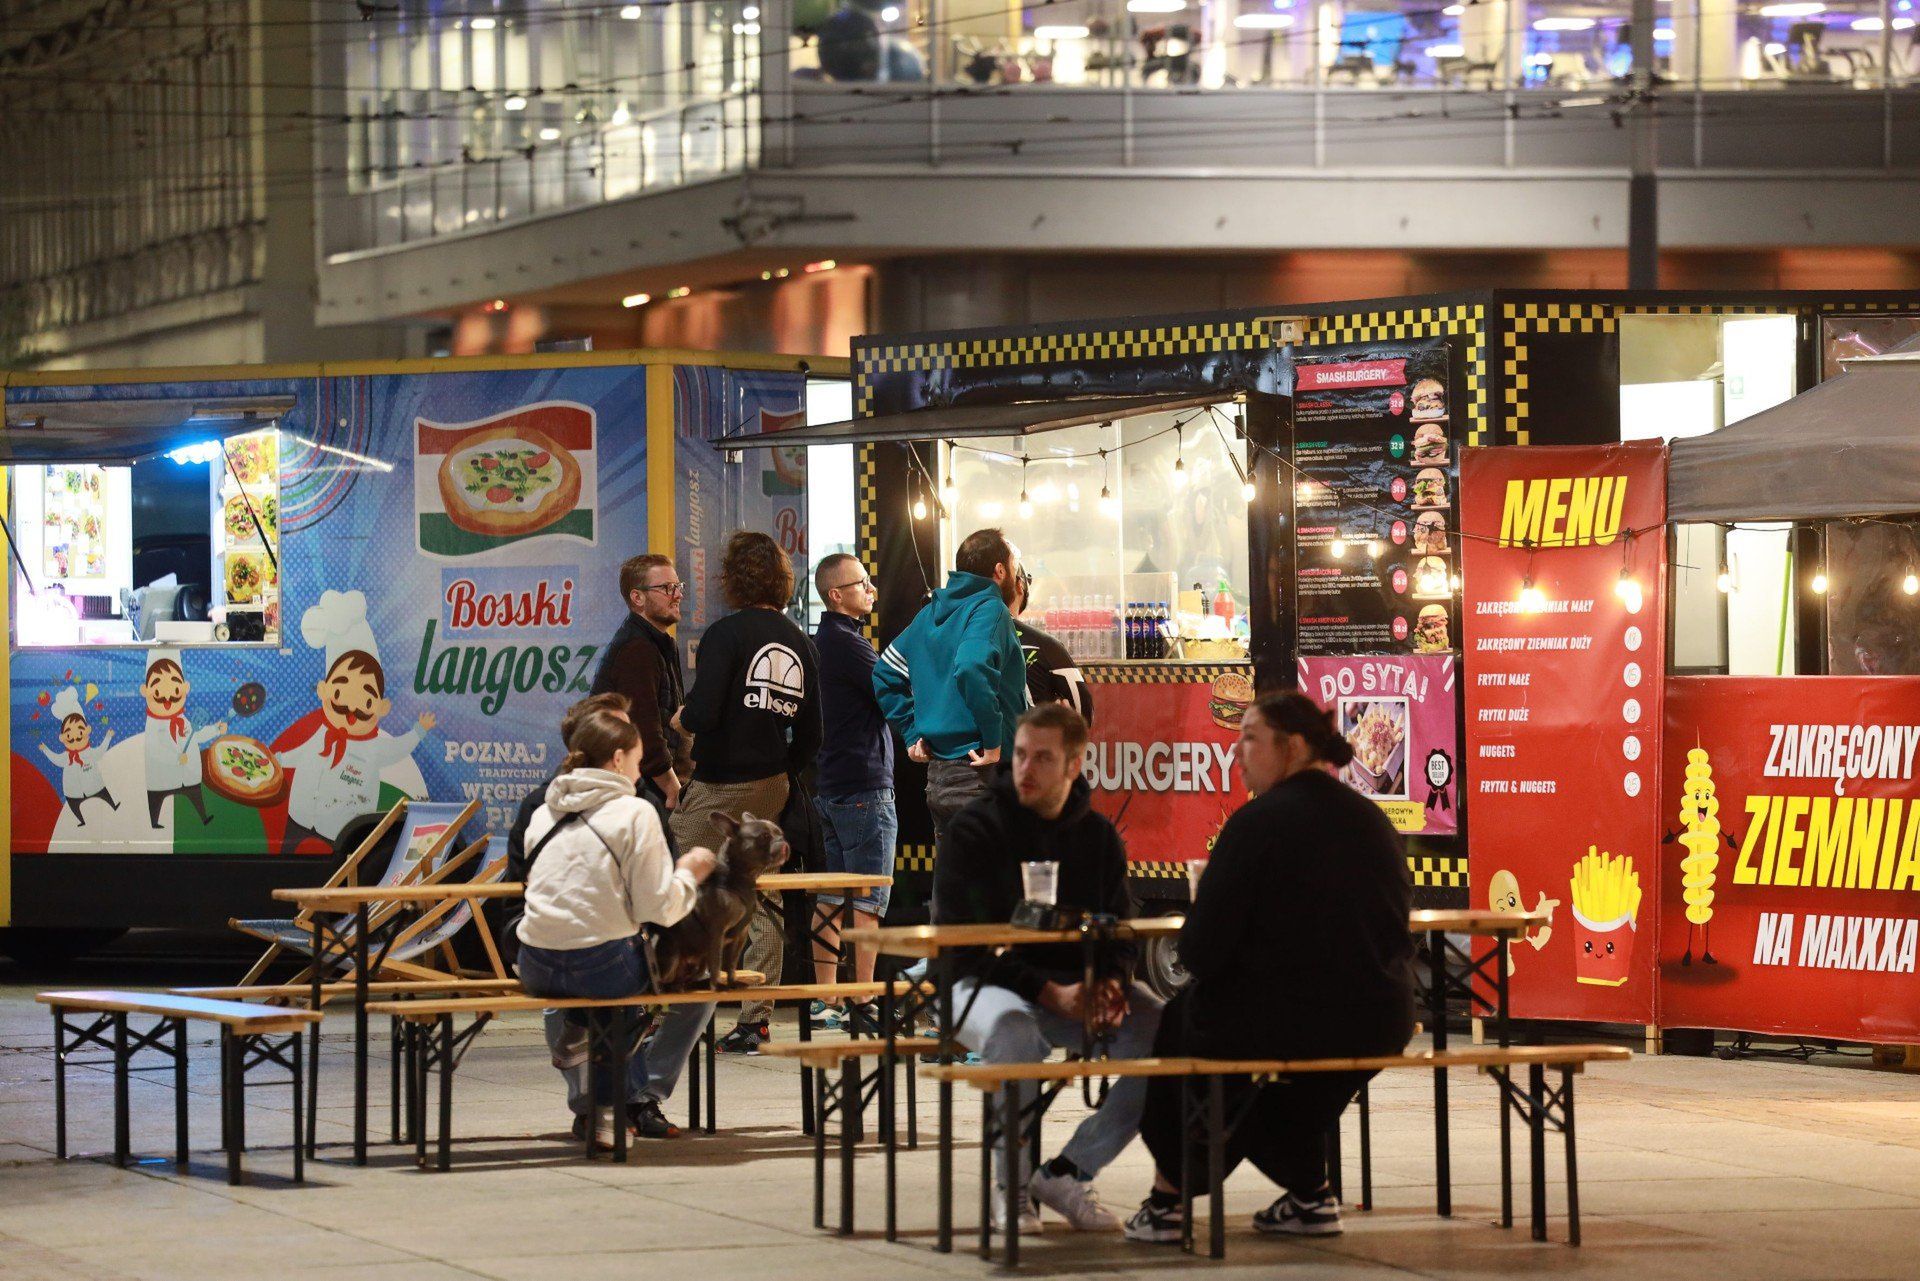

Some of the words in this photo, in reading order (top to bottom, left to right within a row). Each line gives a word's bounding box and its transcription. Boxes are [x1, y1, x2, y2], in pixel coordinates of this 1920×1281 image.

[1316, 371, 1347, 384] SMASH
[1347, 369, 1387, 382] BURGERY
[1390, 441, 1399, 450] 32
[1499, 476, 1628, 548] MENU
[446, 579, 574, 630] Bosski
[1476, 601, 1525, 618] ZAKRĘCON
[1570, 599, 1594, 613] MAŁY
[1476, 637, 1525, 654] ZAKRĘCONY
[1527, 636, 1568, 651] ZIEMNIAK
[1570, 634, 1592, 650] DUŻY
[413, 619, 600, 716] langosz
[1319, 667, 1356, 703] DO
[1361, 662, 1429, 704] SYTA!
[1477, 673, 1506, 686] FRYTKI
[1508, 673, 1531, 686] MAŁE
[1478, 708, 1507, 722] FRYTKI
[1508, 706, 1530, 722] DUŻE
[443, 740, 548, 765] POZNAJ
[1479, 745, 1516, 758] NUGGETS
[1763, 724, 1920, 796] ZAKRĘCONY
[478, 768, 548, 780] TRADYCYJNY
[1082, 741, 1237, 793] BURGERY
[1431, 760, 1445, 771] BEST
[1480, 780, 1509, 793] FRYTKI
[1510, 780, 1517, 793] &
[1520, 780, 1556, 794] NUGGETS
[1753, 911, 1795, 967] NA
[1798, 914, 1919, 974] MAXXXA
